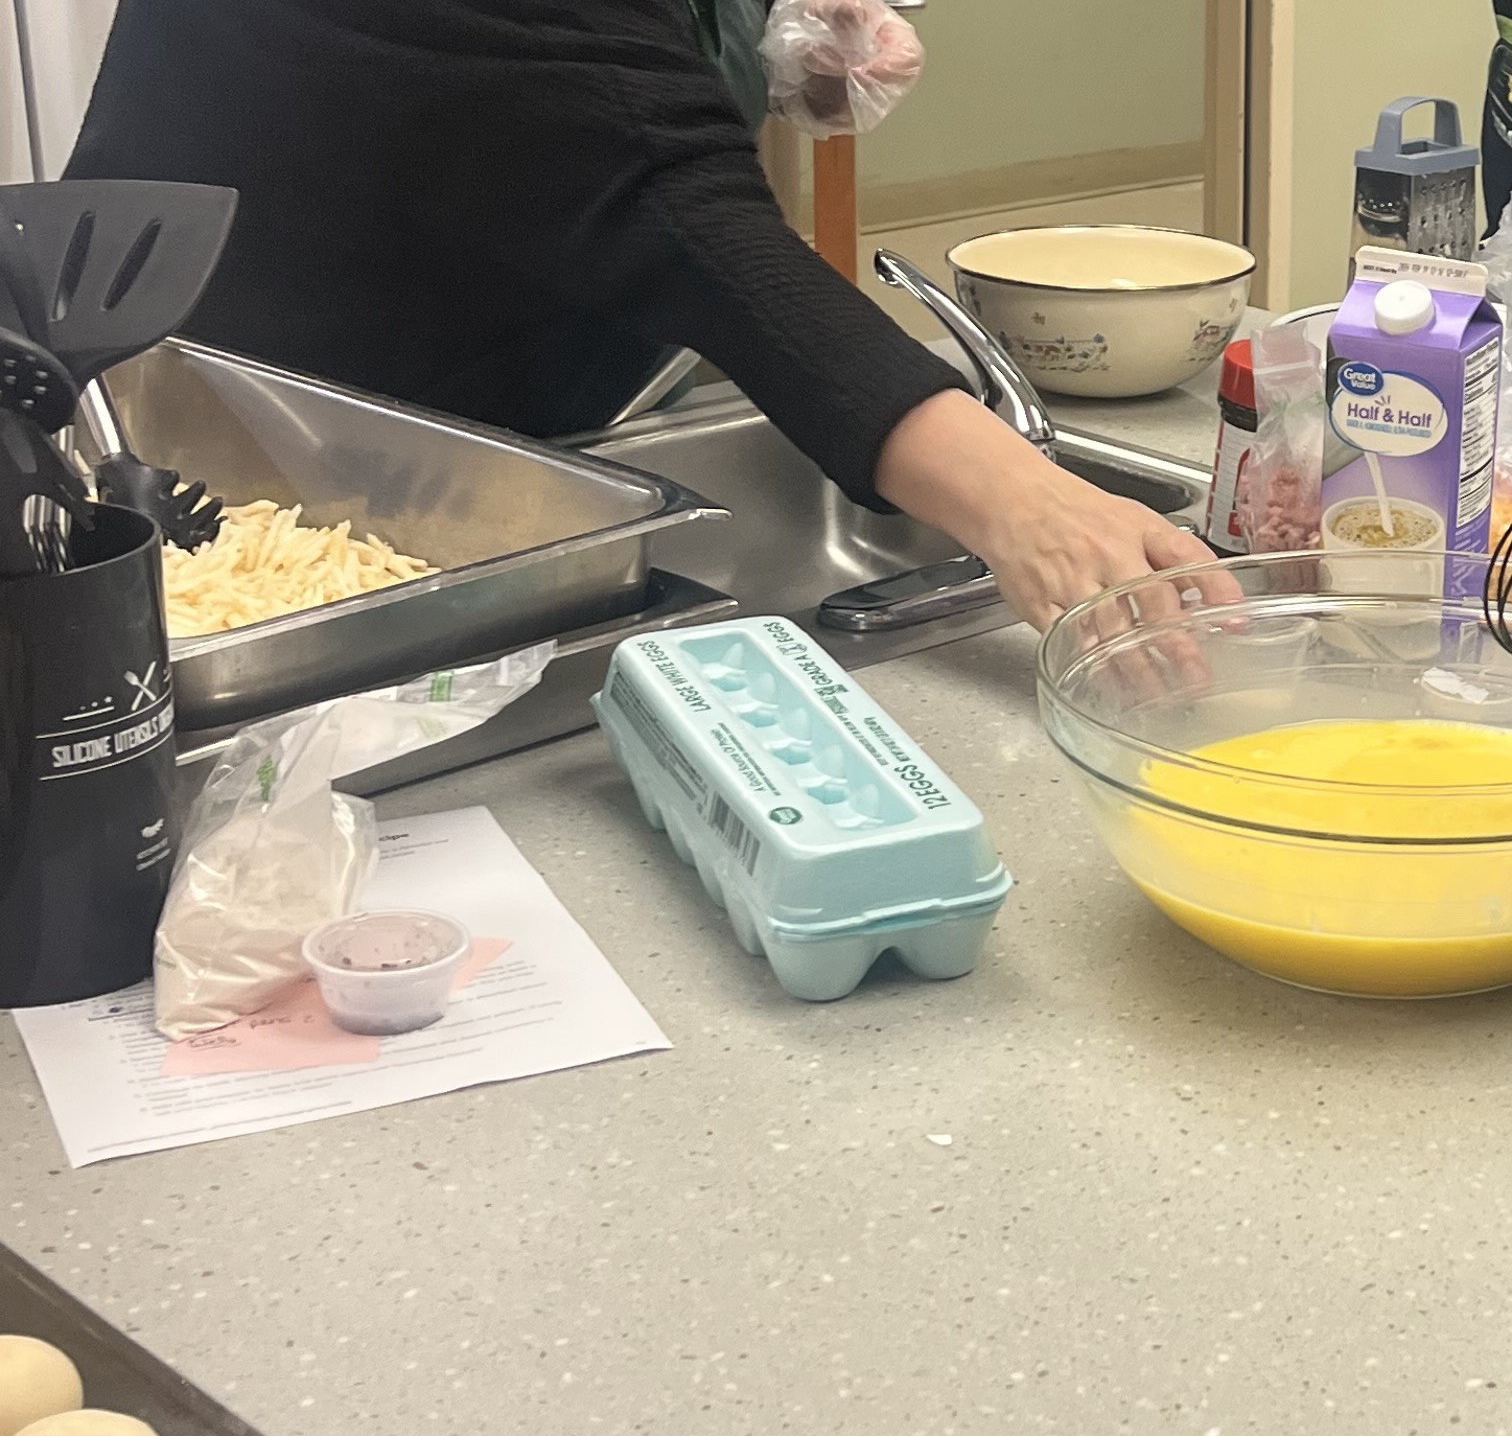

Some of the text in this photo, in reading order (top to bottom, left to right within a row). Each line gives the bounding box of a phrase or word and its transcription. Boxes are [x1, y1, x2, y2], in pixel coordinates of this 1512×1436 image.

[1343, 367, 1376, 383] Great
[1351, 379, 1376, 391] Value
[1347, 403, 1379, 421] Half
[1382, 407, 1395, 423] &
[1398, 409, 1433, 429] Half
[636, 640, 669, 663] EGGS
[655, 661, 688, 691] WHITE
[798, 661, 834, 686] GRADE
[681, 685, 711, 712] LARGE
[52, 736, 112, 767] SILICONE
[113, 716, 159, 754] UTENSILS
[893, 764, 952, 810] 12 EGGS
